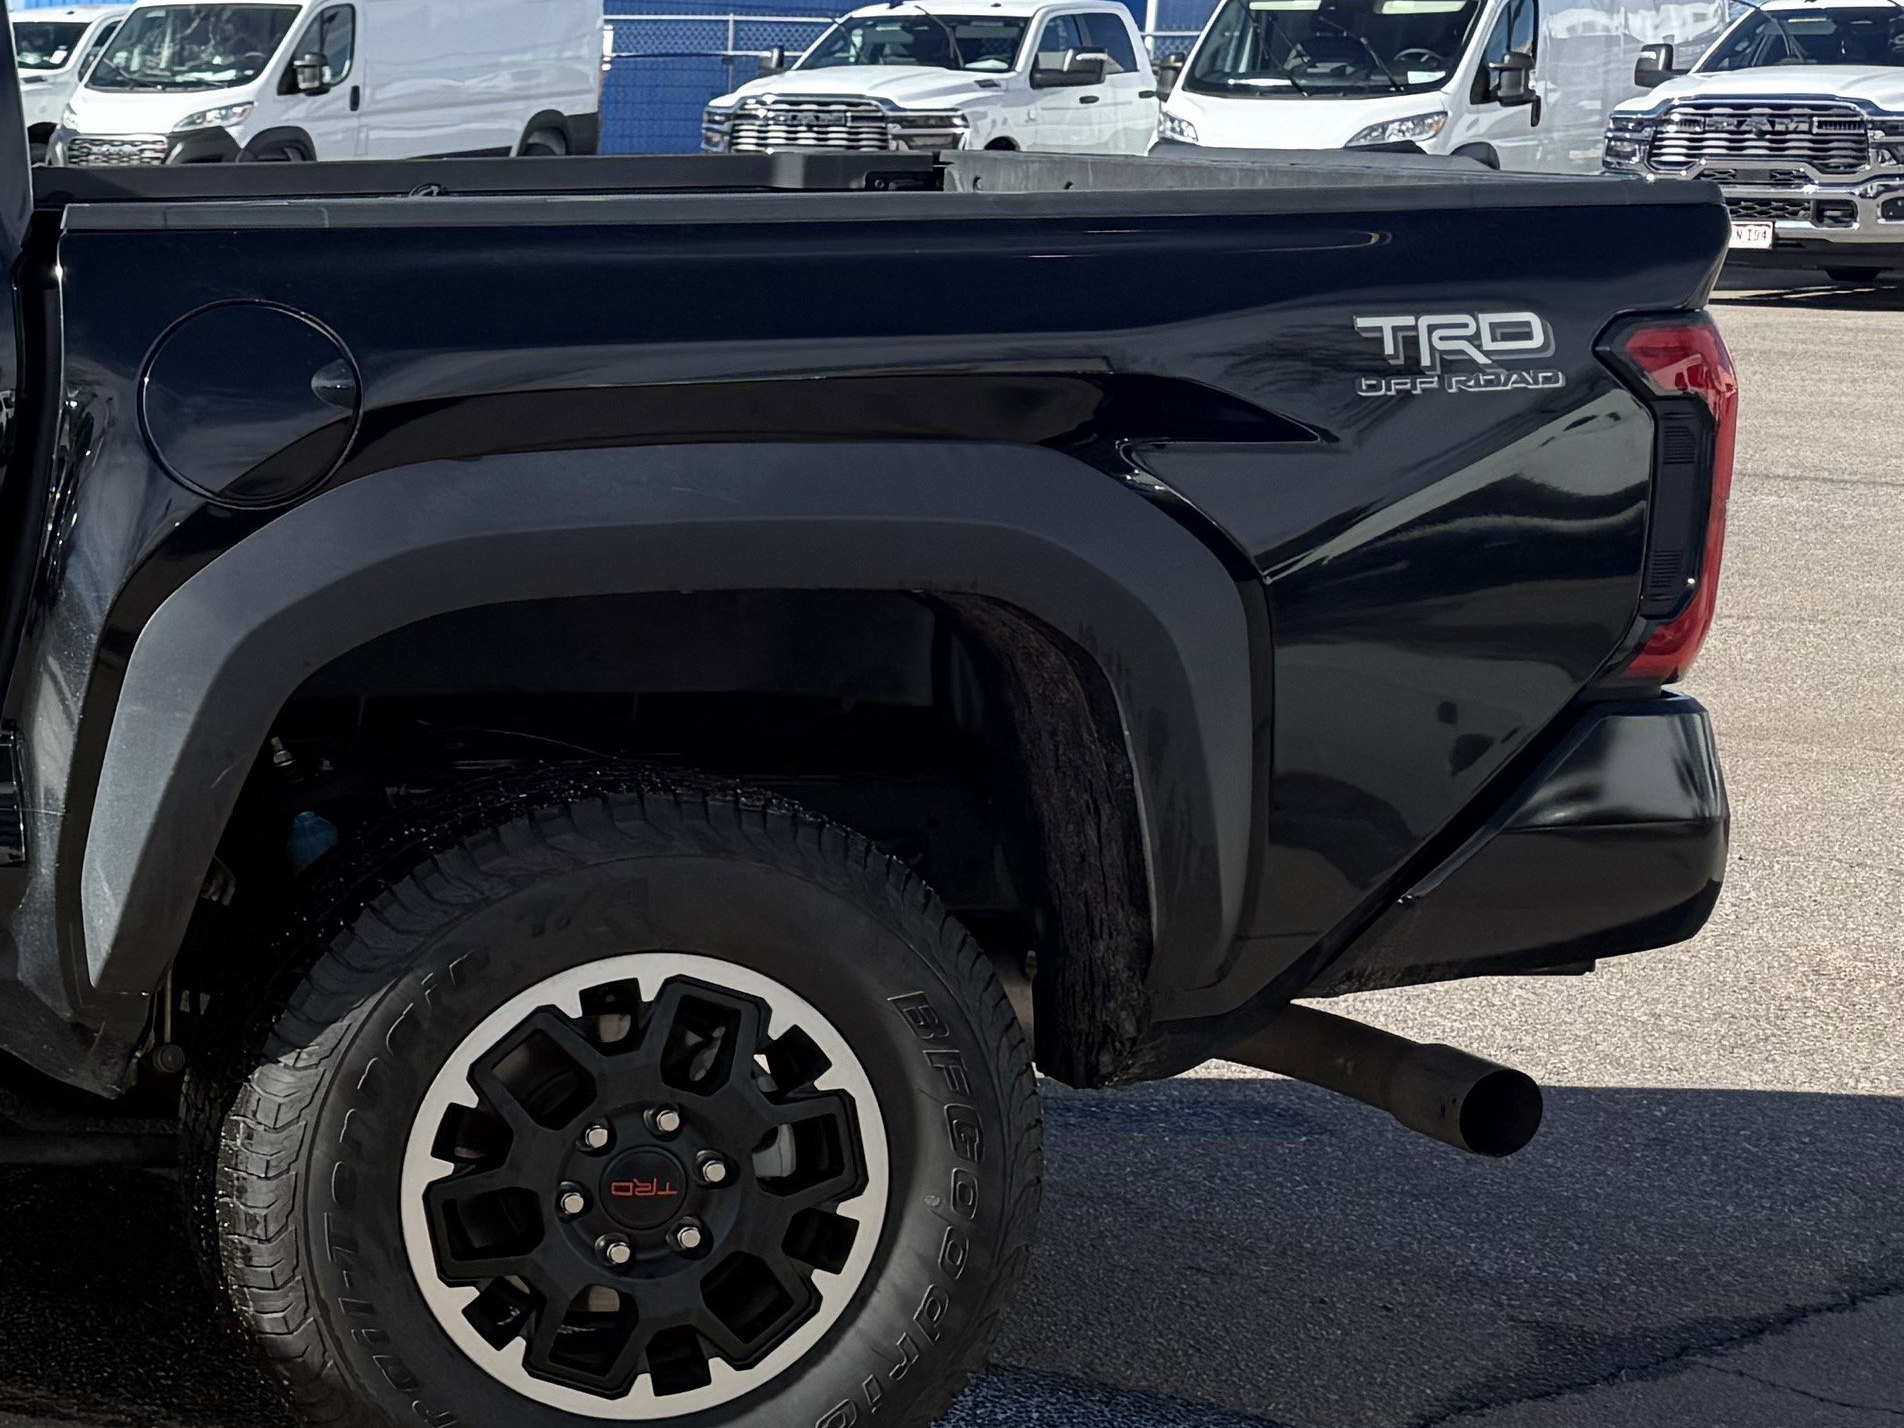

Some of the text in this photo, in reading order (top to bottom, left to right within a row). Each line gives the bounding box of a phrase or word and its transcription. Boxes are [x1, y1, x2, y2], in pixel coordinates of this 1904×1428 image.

[1354, 312, 1553, 372] TRD
[1356, 369, 1567, 397] OFF ROAD
[611, 1178, 679, 1197] TRD
